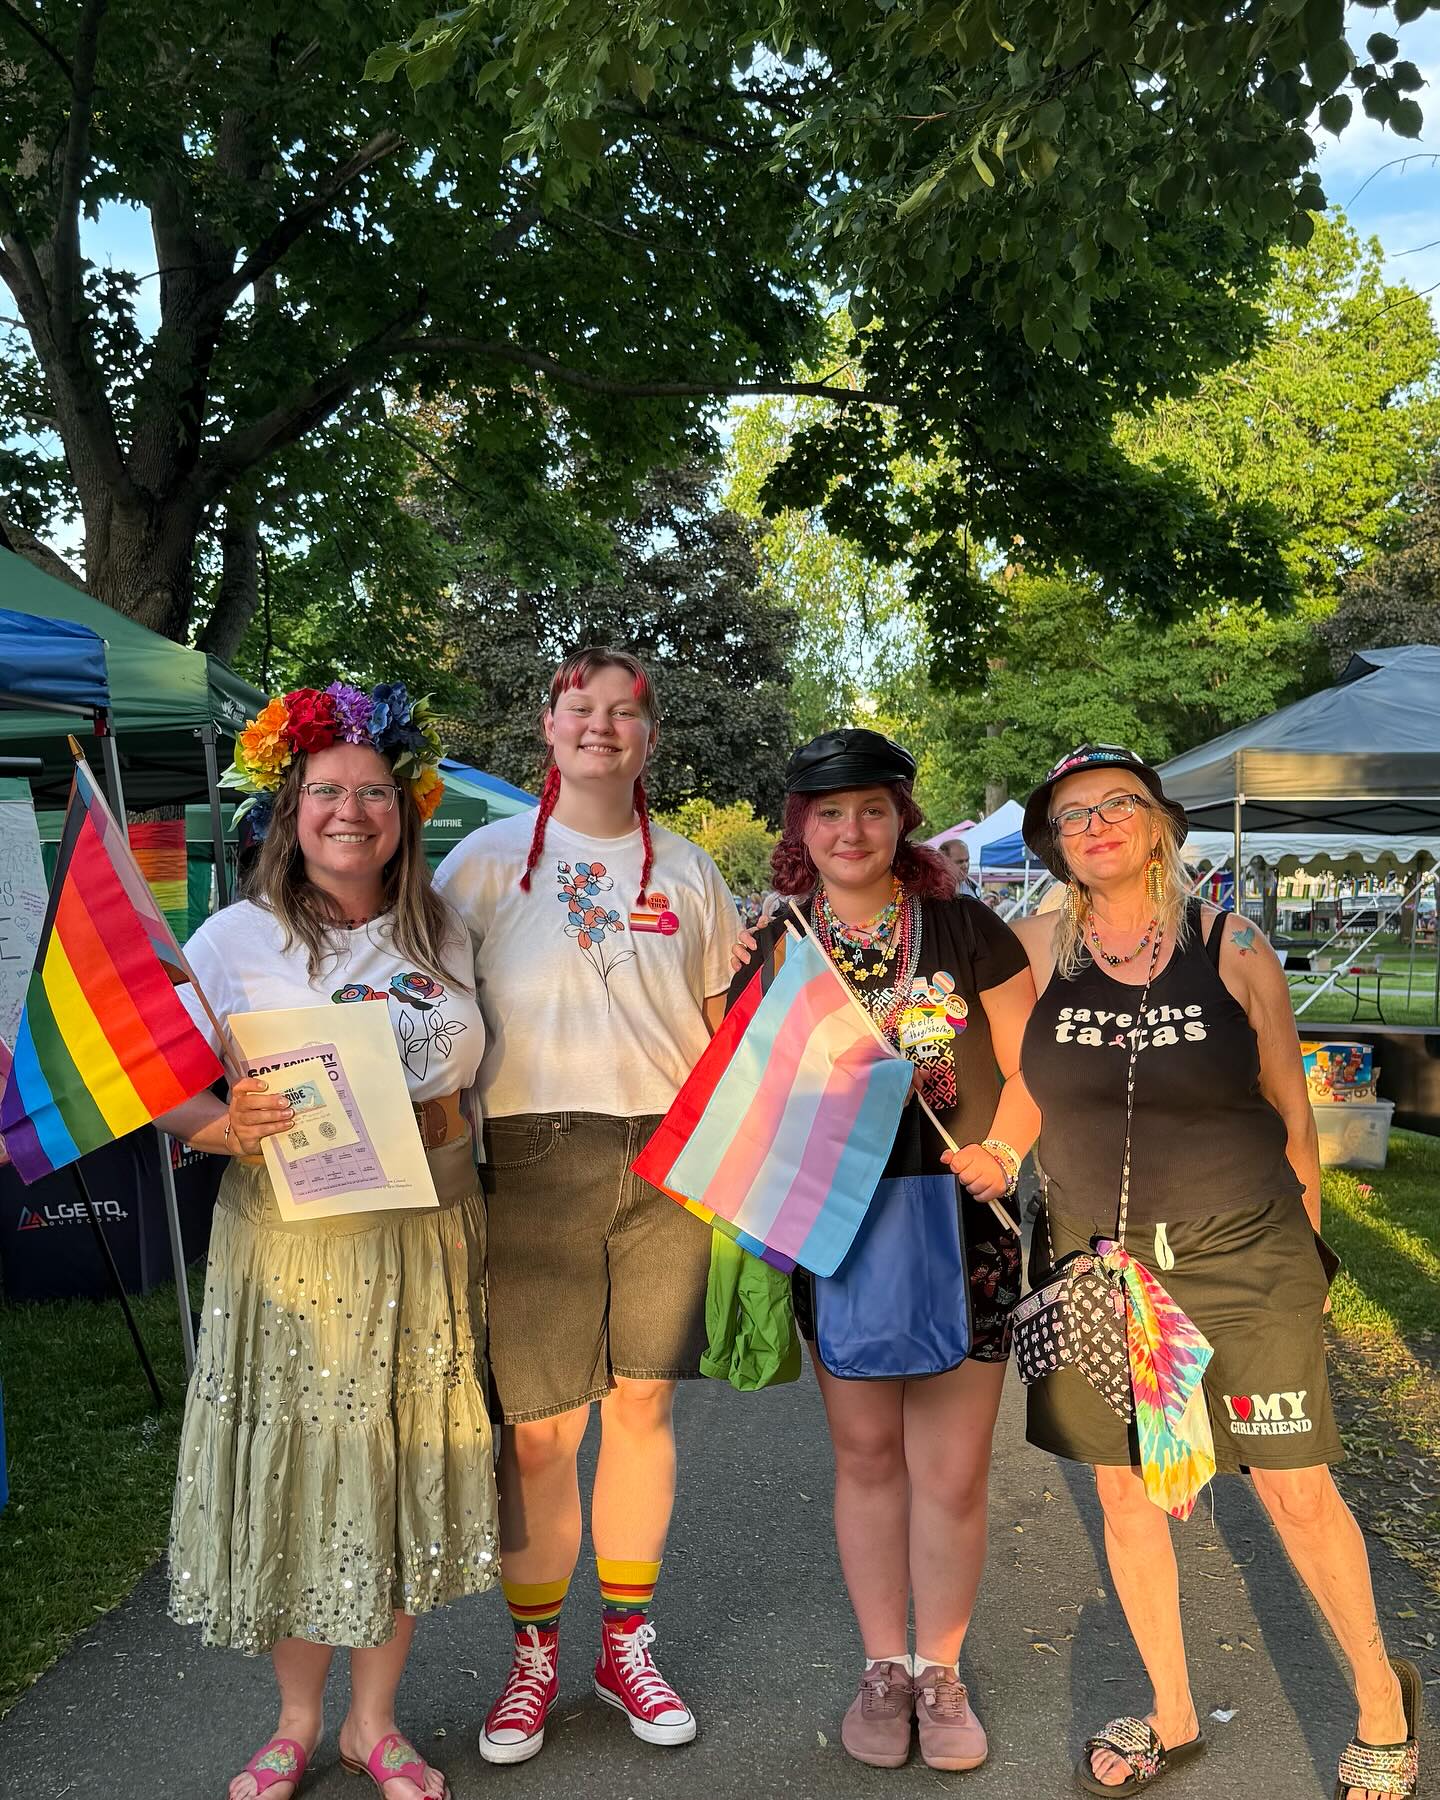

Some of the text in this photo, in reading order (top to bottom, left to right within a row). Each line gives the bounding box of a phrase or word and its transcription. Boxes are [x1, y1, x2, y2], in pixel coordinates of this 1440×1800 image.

[432, 818, 463, 828] OUTFINE
[1058, 1004, 1202, 1028] save the
[281, 1089, 306, 1102] RIDE
[1222, 1390, 1308, 1421] I MY
[1230, 1419, 1312, 1436] GIRLFRIEND
